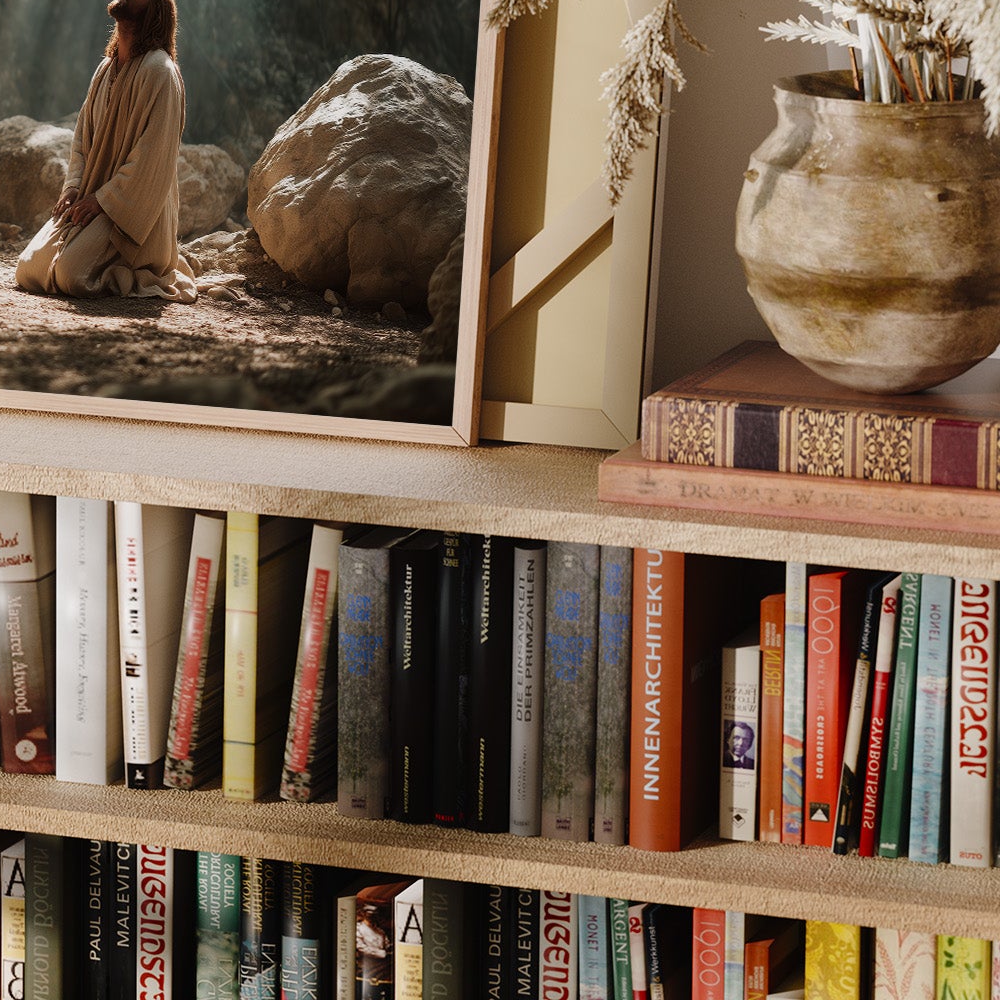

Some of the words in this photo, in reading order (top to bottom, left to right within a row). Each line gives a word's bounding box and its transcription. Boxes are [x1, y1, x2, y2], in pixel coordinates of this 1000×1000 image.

[6, 595, 25, 657] Margaret
[402, 563, 412, 671] Weltarchitektur
[516, 573, 526, 686] EINSAMKEIT
[524, 559, 535, 679] PRIMZAHLEN
[11, 660, 33, 714] Atwood
[516, 692, 524, 722] DIE
[524, 685, 533, 722] DER
[643, 549, 663, 801] INNENARCHITEKTU
[402, 746, 410, 814] westermann
[477, 737, 486, 821] westermann
[89, 840, 102, 910] DELVAU
[89, 916, 102, 961] PAUL
[488, 885, 502, 957] DELVAU
[587, 914, 599, 952] MONET
[613, 899, 629, 965] ARGENT
[629, 916, 643, 934] 2
[647, 926, 660, 975] Werkkunst
[693, 921, 721, 986] 1900
[587, 957, 599, 969] IN
